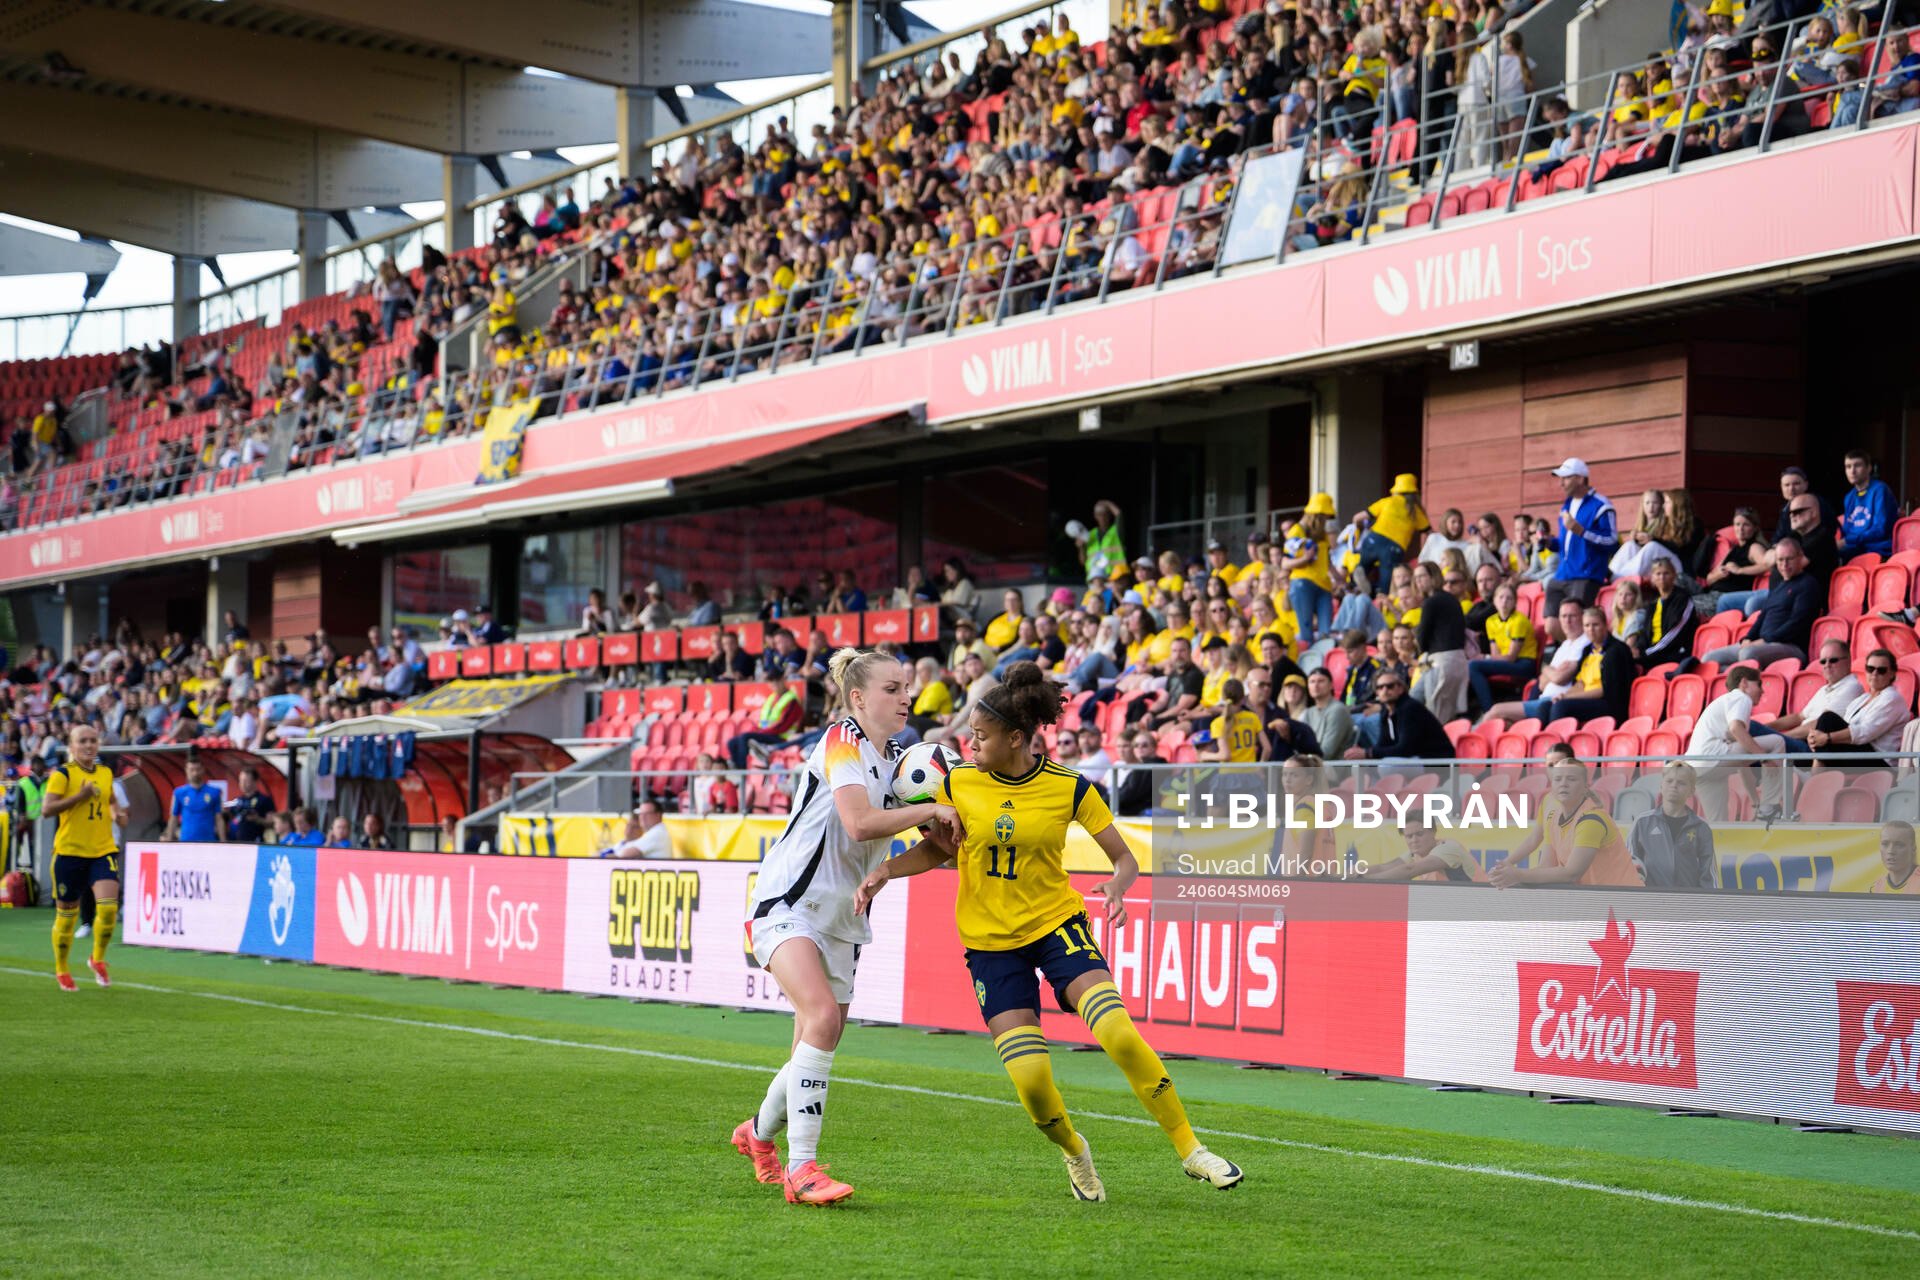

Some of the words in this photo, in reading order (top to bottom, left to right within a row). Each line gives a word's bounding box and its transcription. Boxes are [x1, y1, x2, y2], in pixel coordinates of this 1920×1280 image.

[1416, 244, 1502, 311] VISMA
[1536, 235, 1593, 286] Spcs
[991, 338, 1053, 393] VISMA
[1074, 335, 1113, 376] Spcs
[1234, 729, 1253, 749] 10
[88, 802, 103, 820] 14
[986, 845, 1018, 881] 11
[161, 870, 212, 900] SVENSKA
[160, 906, 186, 936] SPEL
[374, 872, 453, 956] VISMA
[484, 884, 540, 963] Spcs
[608, 868, 700, 964] SPORT
[1055, 923, 1096, 956] 11
[610, 964, 692, 993] BLADET
[1530, 979, 1682, 1069] Estrella
[801, 1078, 827, 1089] DFB
